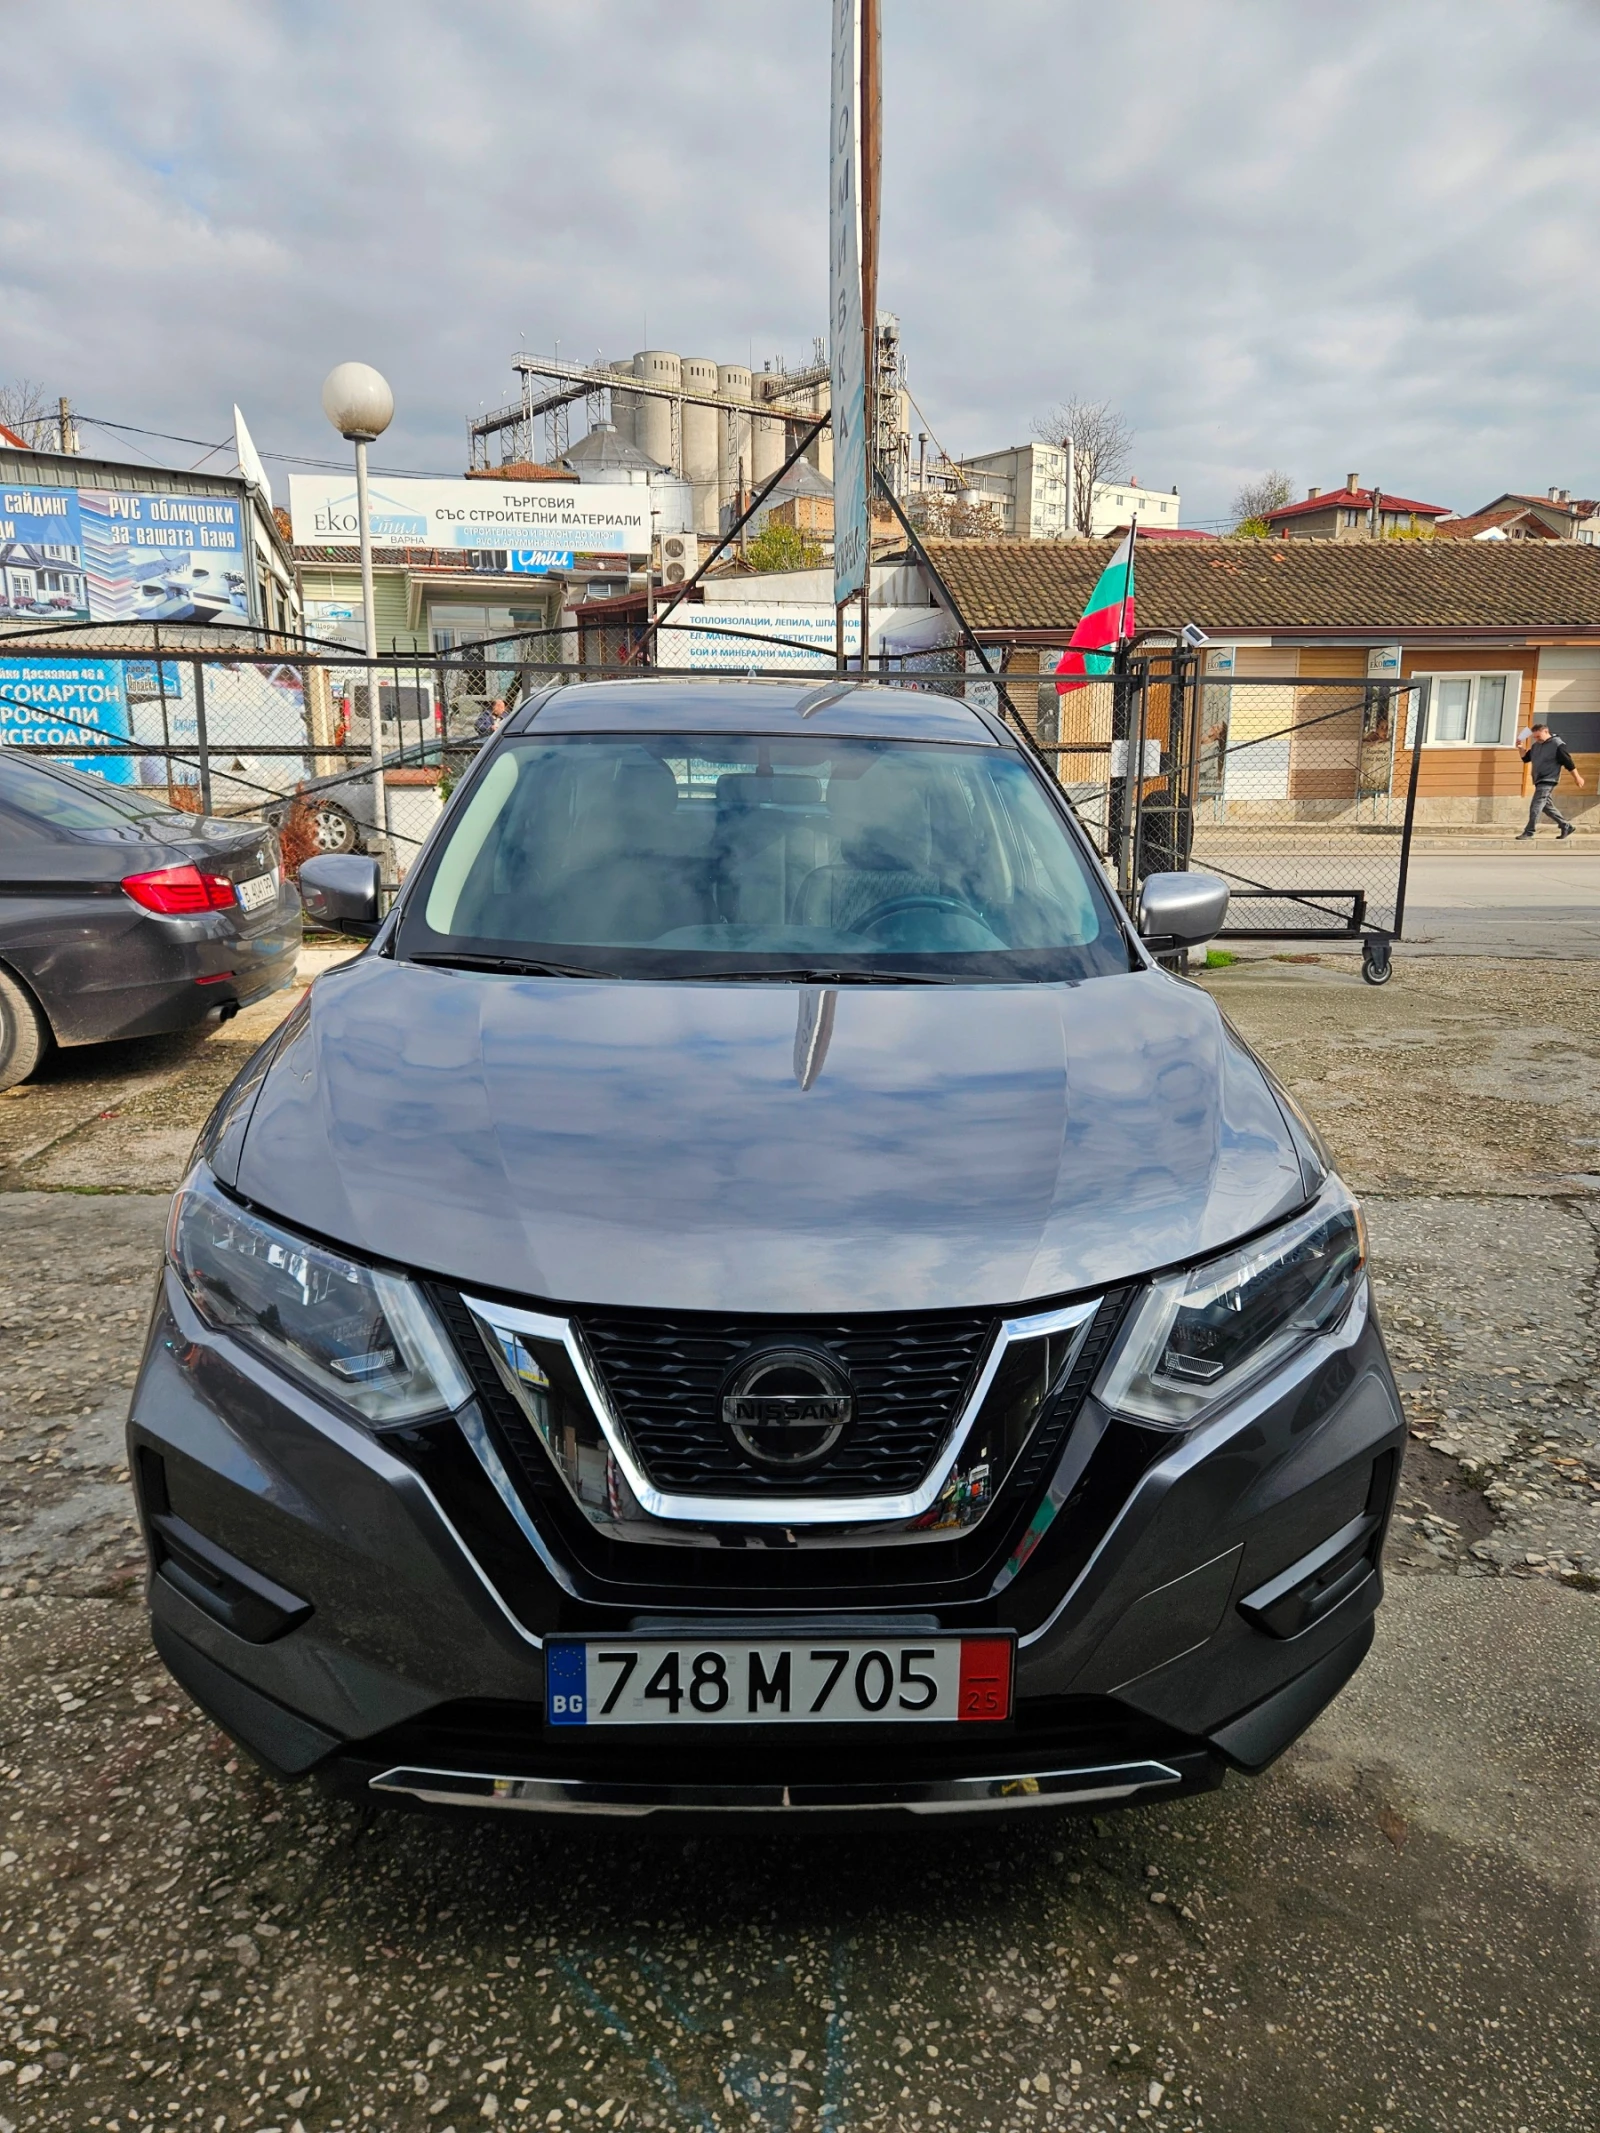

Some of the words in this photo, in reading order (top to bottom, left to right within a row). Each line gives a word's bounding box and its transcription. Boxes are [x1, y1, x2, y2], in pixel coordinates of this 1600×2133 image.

[4, 492, 68, 517] сайдинг
[109, 497, 141, 520] PVC
[150, 499, 234, 525] облицовки
[503, 496, 575, 509] ТЪРГОВИЯ
[435, 509, 465, 520] СЪС
[469, 510, 558, 524] СТРОИТЕЛНИ
[561, 513, 641, 526] МАТЕРИАЛИ
[111, 526, 130, 545] за
[136, 527, 194, 547] вашата
[200, 526, 235, 548] баня
[391, 536, 425, 544] ВАРНА
[538, 530, 573, 539] РЕМОНТ
[575, 531, 587, 540] ДО
[690, 616, 773, 627] ТОПЛОИЗОЛАЦИИ,
[774, 618, 813, 628] ЛЕПИЛА,
[711, 648, 718, 656] И
[720, 649, 775, 658] МИНЕРАЛНИ
[1, 684, 120, 702] СОКАРТОН
[736, 1403, 838, 1420] NISSAN
[598, 1651, 729, 1714] 748
[748, 1651, 791, 1713] M
[809, 1649, 938, 1712] 705
[553, 1695, 583, 1713] BG
[967, 1690, 998, 1711] 25
